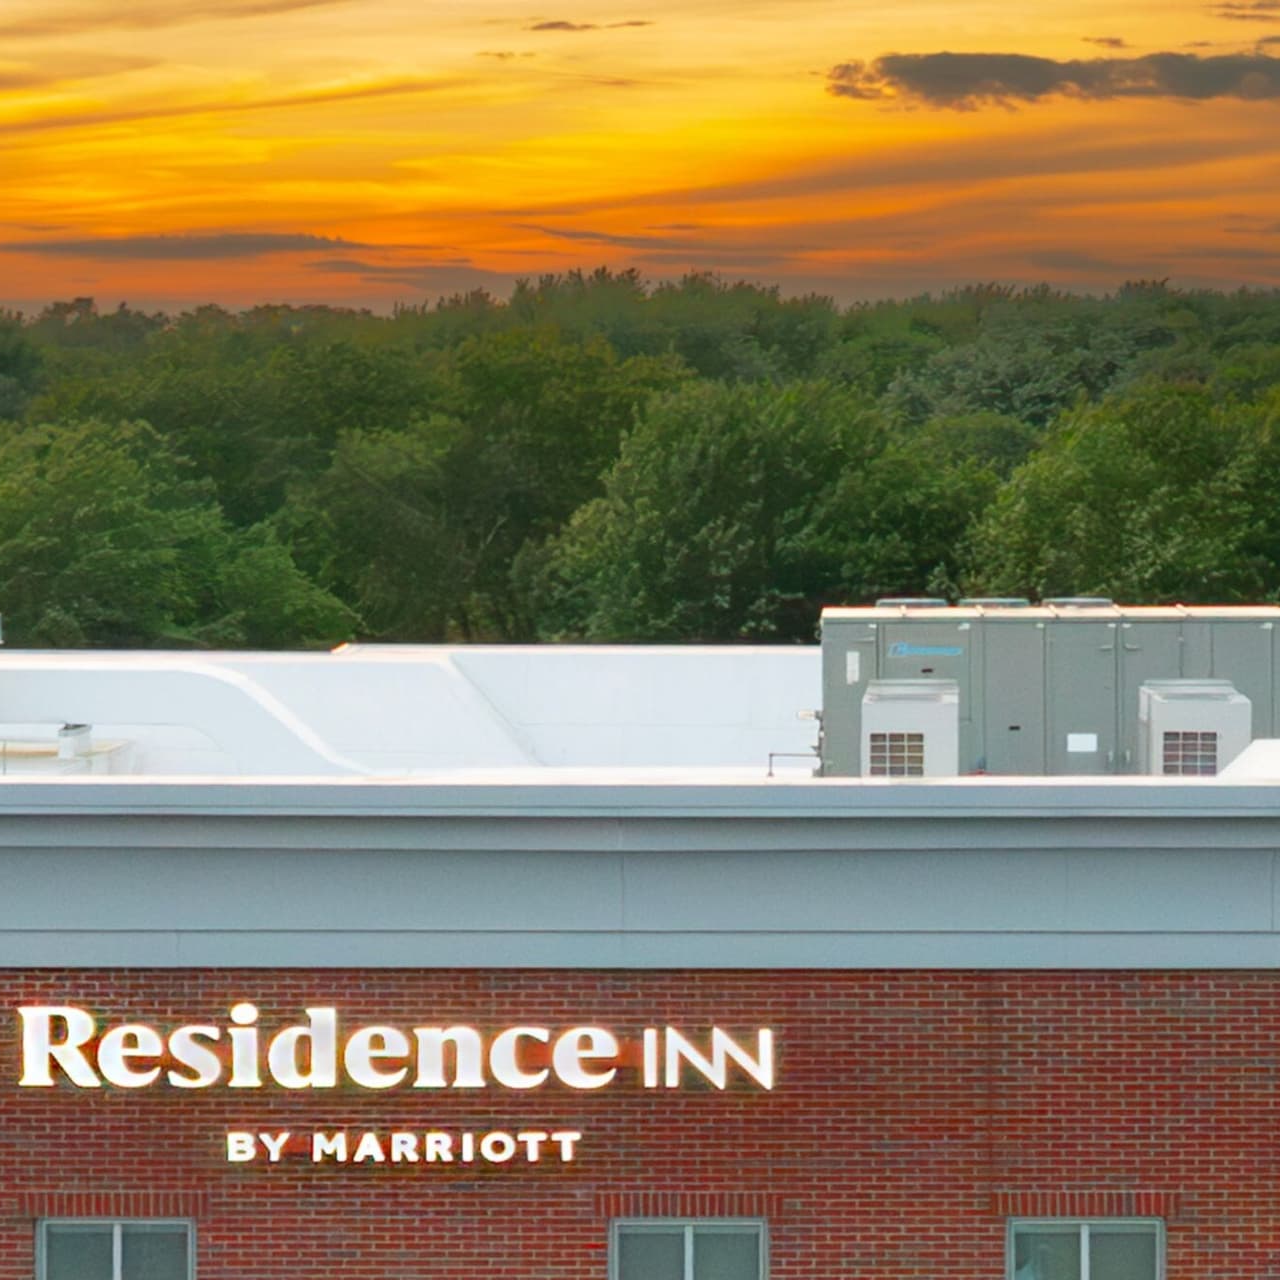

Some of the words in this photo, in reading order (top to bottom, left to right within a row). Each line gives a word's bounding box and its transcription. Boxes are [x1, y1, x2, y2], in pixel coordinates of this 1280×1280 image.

[16, 1003, 618, 1090] Residence
[642, 1026, 774, 1091] INN
[226, 1131, 291, 1163] BY
[312, 1131, 582, 1164] MARRIOTT
